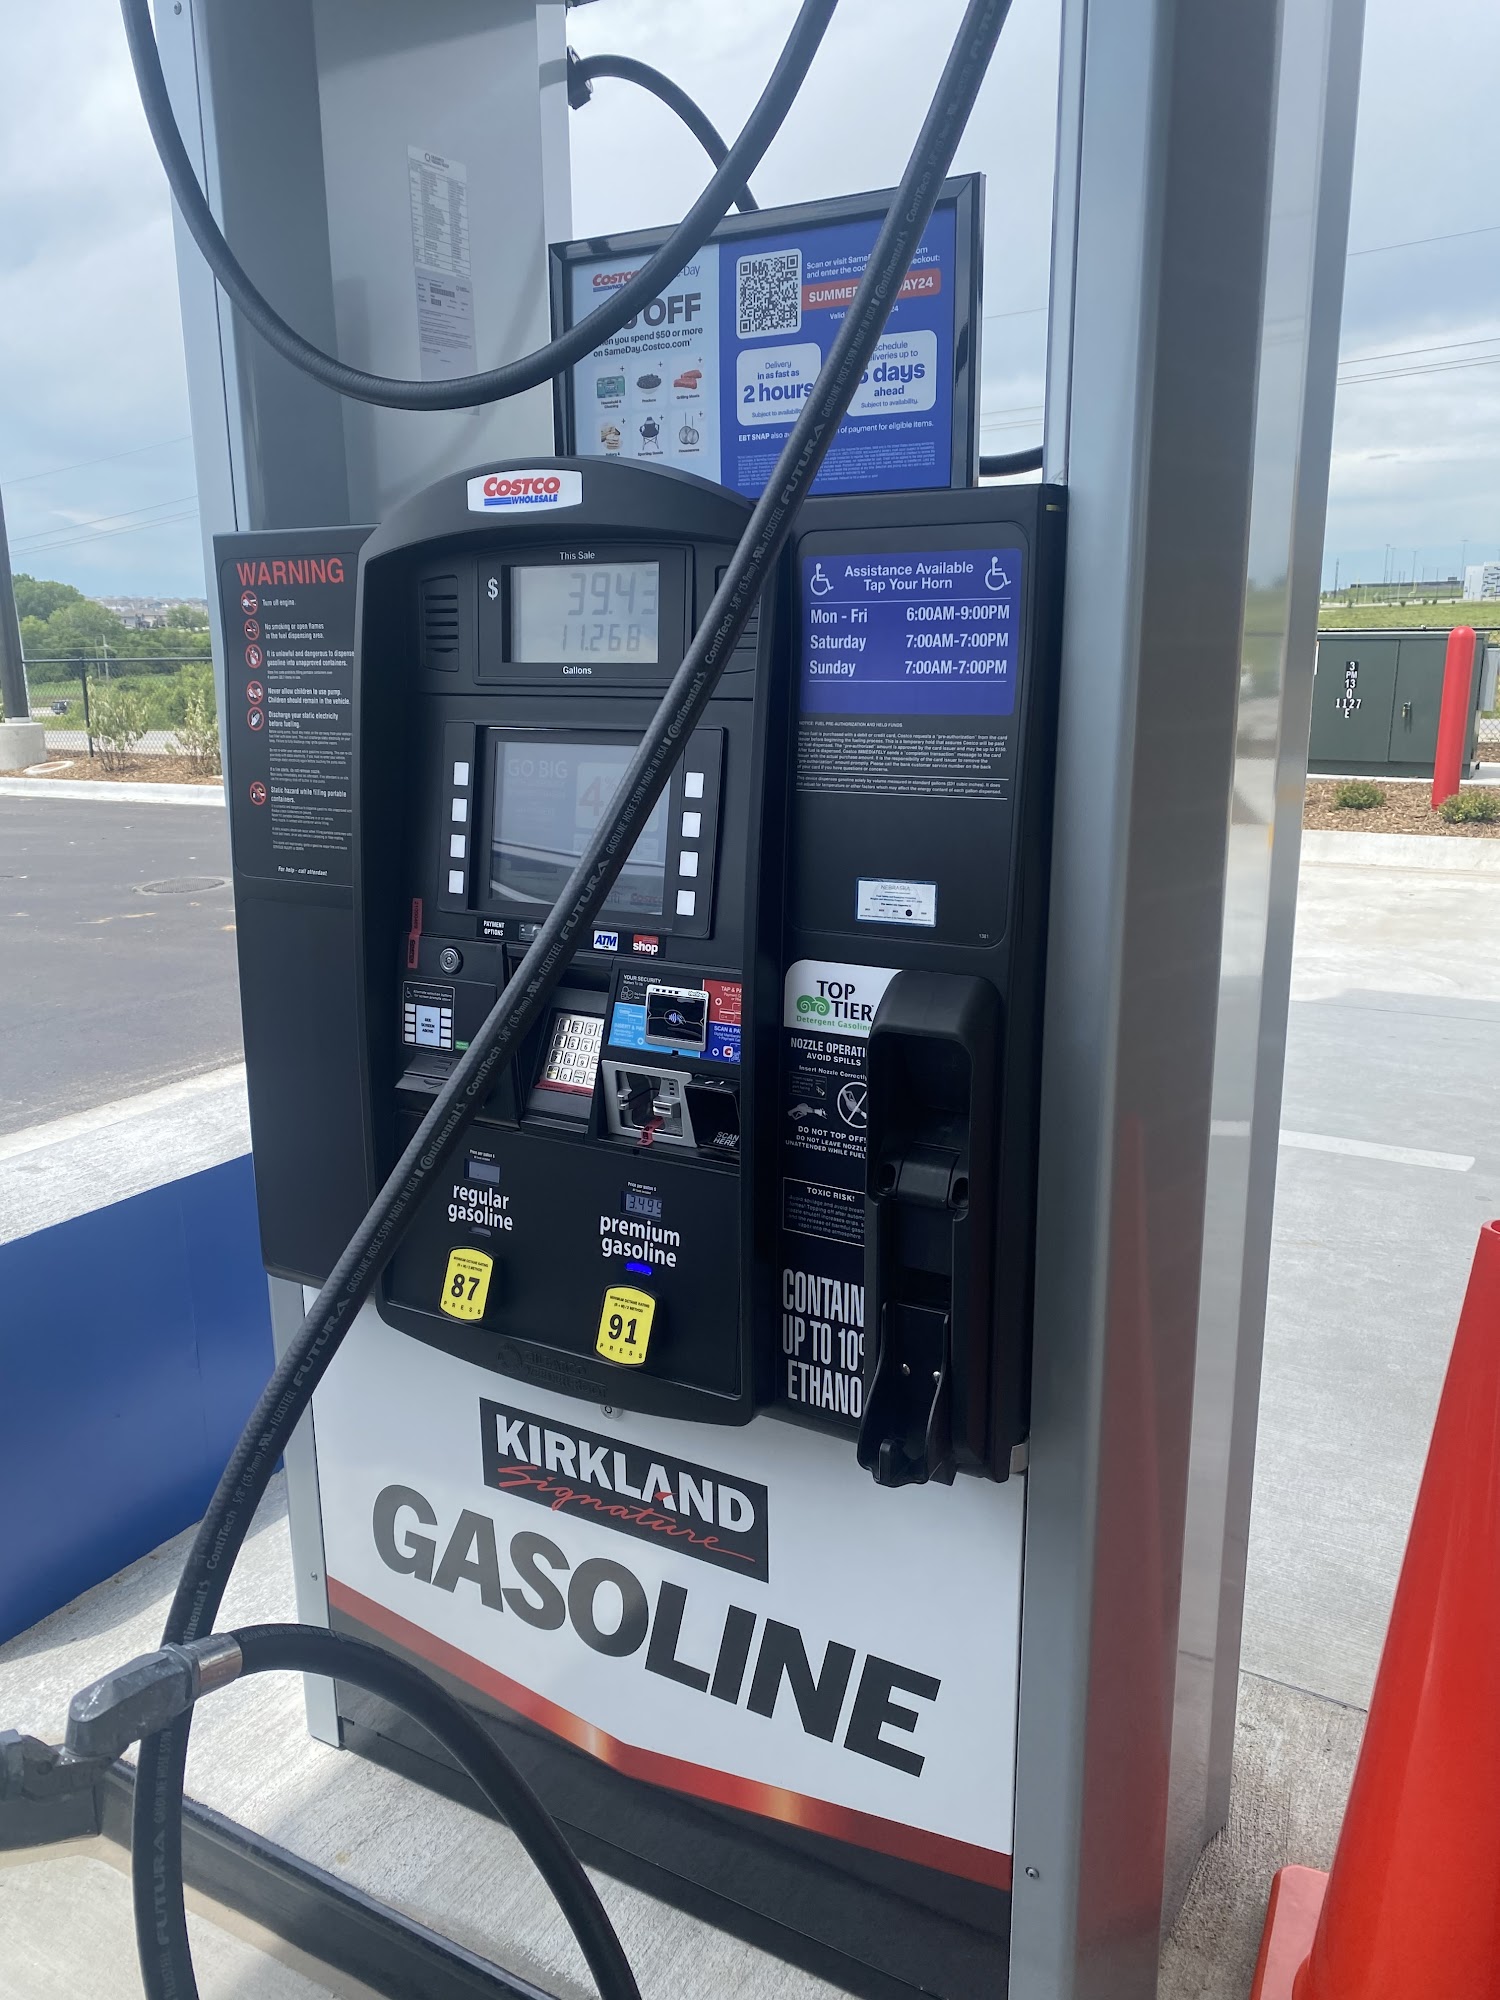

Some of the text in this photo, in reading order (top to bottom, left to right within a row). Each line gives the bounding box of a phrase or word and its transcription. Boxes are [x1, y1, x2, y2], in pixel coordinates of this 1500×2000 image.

[806, 257, 847, 270] Scan visit
[806, 266, 852, 279] and enter the
[643, 292, 702, 327] OFF
[829, 312, 845, 320] Valid
[614, 335, 629, 346] you
[631, 332, 655, 343] spend
[656, 330, 671, 339] $50
[682, 327, 703, 335] more
[870, 351, 897, 361] liveries
[899, 351, 909, 359] up
[765, 361, 792, 370] Delivery
[873, 362, 925, 383] days
[757, 372, 765, 380] in
[775, 370, 790, 378] fast
[743, 383, 814, 404] 2 hours
[874, 385, 905, 397] ahead
[861, 401, 881, 409] Subject
[848, 424, 877, 434] payment
[889, 421, 913, 430] eligible
[913, 420, 934, 428] items.
[752, 432, 770, 440] SNAP
[780, 424, 825, 504] FUTURA
[483, 476, 561, 497] COSTCO
[511, 494, 558, 505] WHOLESALE
[559, 551, 596, 560] This Sale
[236, 557, 344, 587] WARNING
[844, 561, 974, 577] Assistance Available
[487, 577, 498, 600] $
[864, 577, 953, 593] Tap Your Horn
[810, 609, 838, 624] Mon
[850, 608, 868, 623] Fri
[906, 605, 1010, 621] 6:00AM-9:00PM
[272, 623, 291, 631] smoking
[288, 632, 312, 640] dispensing
[562, 624, 642, 652] 11.268
[705, 612, 735, 665] ContiTech
[810, 633, 1009, 652] Saturday 7:00AM-7:00PM
[304, 650, 328, 658] dangerous
[267, 659, 286, 667] gasoline
[296, 659, 321, 667] unapproved
[563, 666, 592, 675] Gallons
[809, 660, 1007, 677] Sunday 7:00AM-7:00PM
[1349, 661, 1355, 671] 3
[1346, 671, 1358, 679] PM
[1345, 679, 1356, 688] 13
[667, 679, 703, 739] Continental
[1336, 698, 1361, 709] 1127
[268, 711, 290, 719] Discharge
[315, 712, 339, 720] electricity
[1345, 708, 1350, 718] E
[508, 759, 568, 778] GO BIG
[270, 786, 283, 794] Static
[284, 787, 299, 795] hazard
[312, 789, 327, 797] filling
[606, 822, 629, 854] GASOLINE
[622, 804, 637, 823] HOSE
[641, 767, 656, 788] MADE
[657, 744, 668, 760] USA
[560, 859, 610, 941] FUTURA
[483, 920, 505, 928] PAYMENT
[484, 928, 504, 936] OPTIONS
[594, 934, 617, 946] ATM
[633, 941, 658, 955] shop
[539, 943, 563, 976] FLEXSTEEL
[816, 980, 856, 999] TOP
[831, 1000, 873, 1022] TIER
[797, 1015, 835, 1026] Detergent
[791, 1037, 866, 1058] NOZZLE OPERATI
[807, 1052, 861, 1066] AVOID SPILLS
[466, 1046, 500, 1096] ContiTech
[819, 1068, 838, 1076] Nozzle
[716, 1131, 739, 1141] SCAN
[812, 1128, 828, 1136] NOT
[830, 1131, 846, 1139] TOP
[713, 1137, 737, 1147] HERE
[785, 1140, 826, 1151] UNATTENDED
[828, 1147, 848, 1155] WHILE
[821, 1139, 841, 1147] LEAVE
[453, 1184, 510, 1210] regular
[807, 1187, 855, 1202] TOXIC RISK!
[448, 1201, 514, 1231] gasoline
[600, 1215, 680, 1247] premium
[602, 1237, 677, 1268] gasoline
[451, 1273, 480, 1301] 87
[782, 1268, 865, 1328] CONTAIN
[608, 1314, 637, 1344] 91
[293, 1298, 350, 1387] FUTURA
[782, 1313, 832, 1365] UP TO
[787, 1359, 863, 1419] ETHANO
[496, 1414, 755, 1533] KIRKLAND
[497, 1465, 756, 1562] Signature
[372, 1484, 942, 1777] GASOLINE
[153, 1829, 170, 1946] FUTURA
